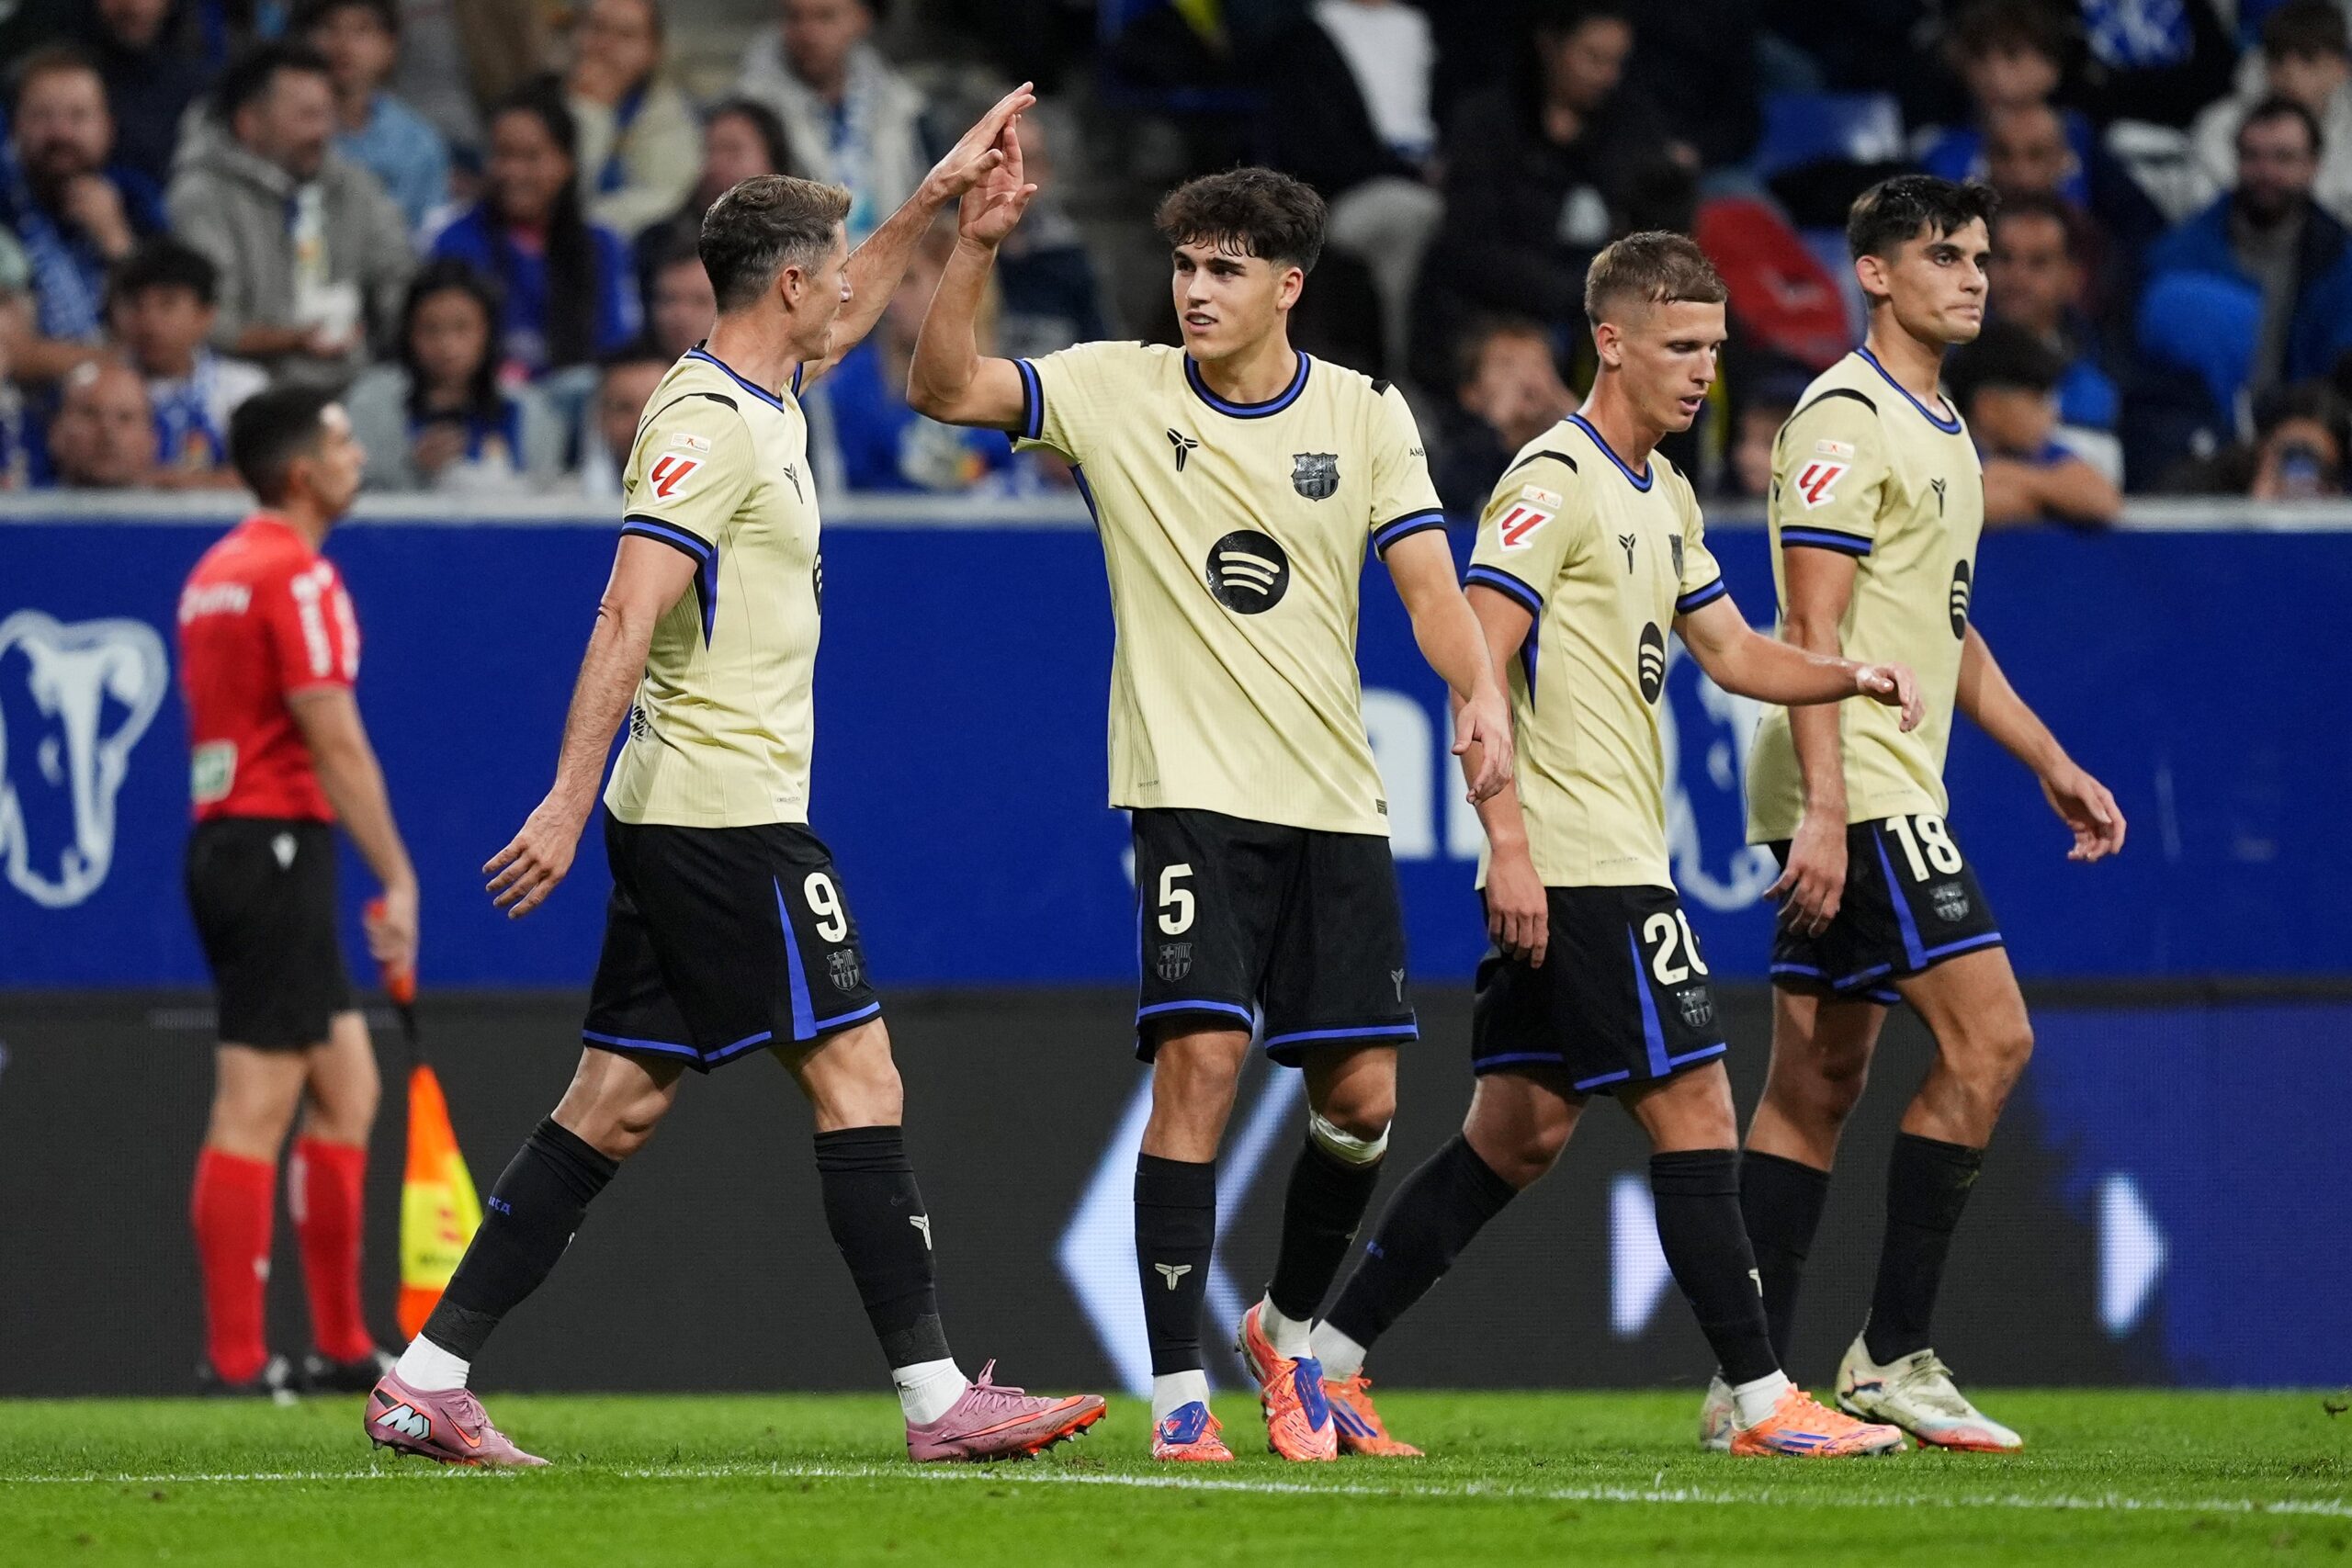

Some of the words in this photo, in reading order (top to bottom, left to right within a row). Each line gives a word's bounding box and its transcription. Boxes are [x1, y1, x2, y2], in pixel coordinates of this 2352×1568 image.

[1885, 814, 1962, 882] 18
[804, 872, 847, 942] 9
[1158, 863, 1195, 935] 5
